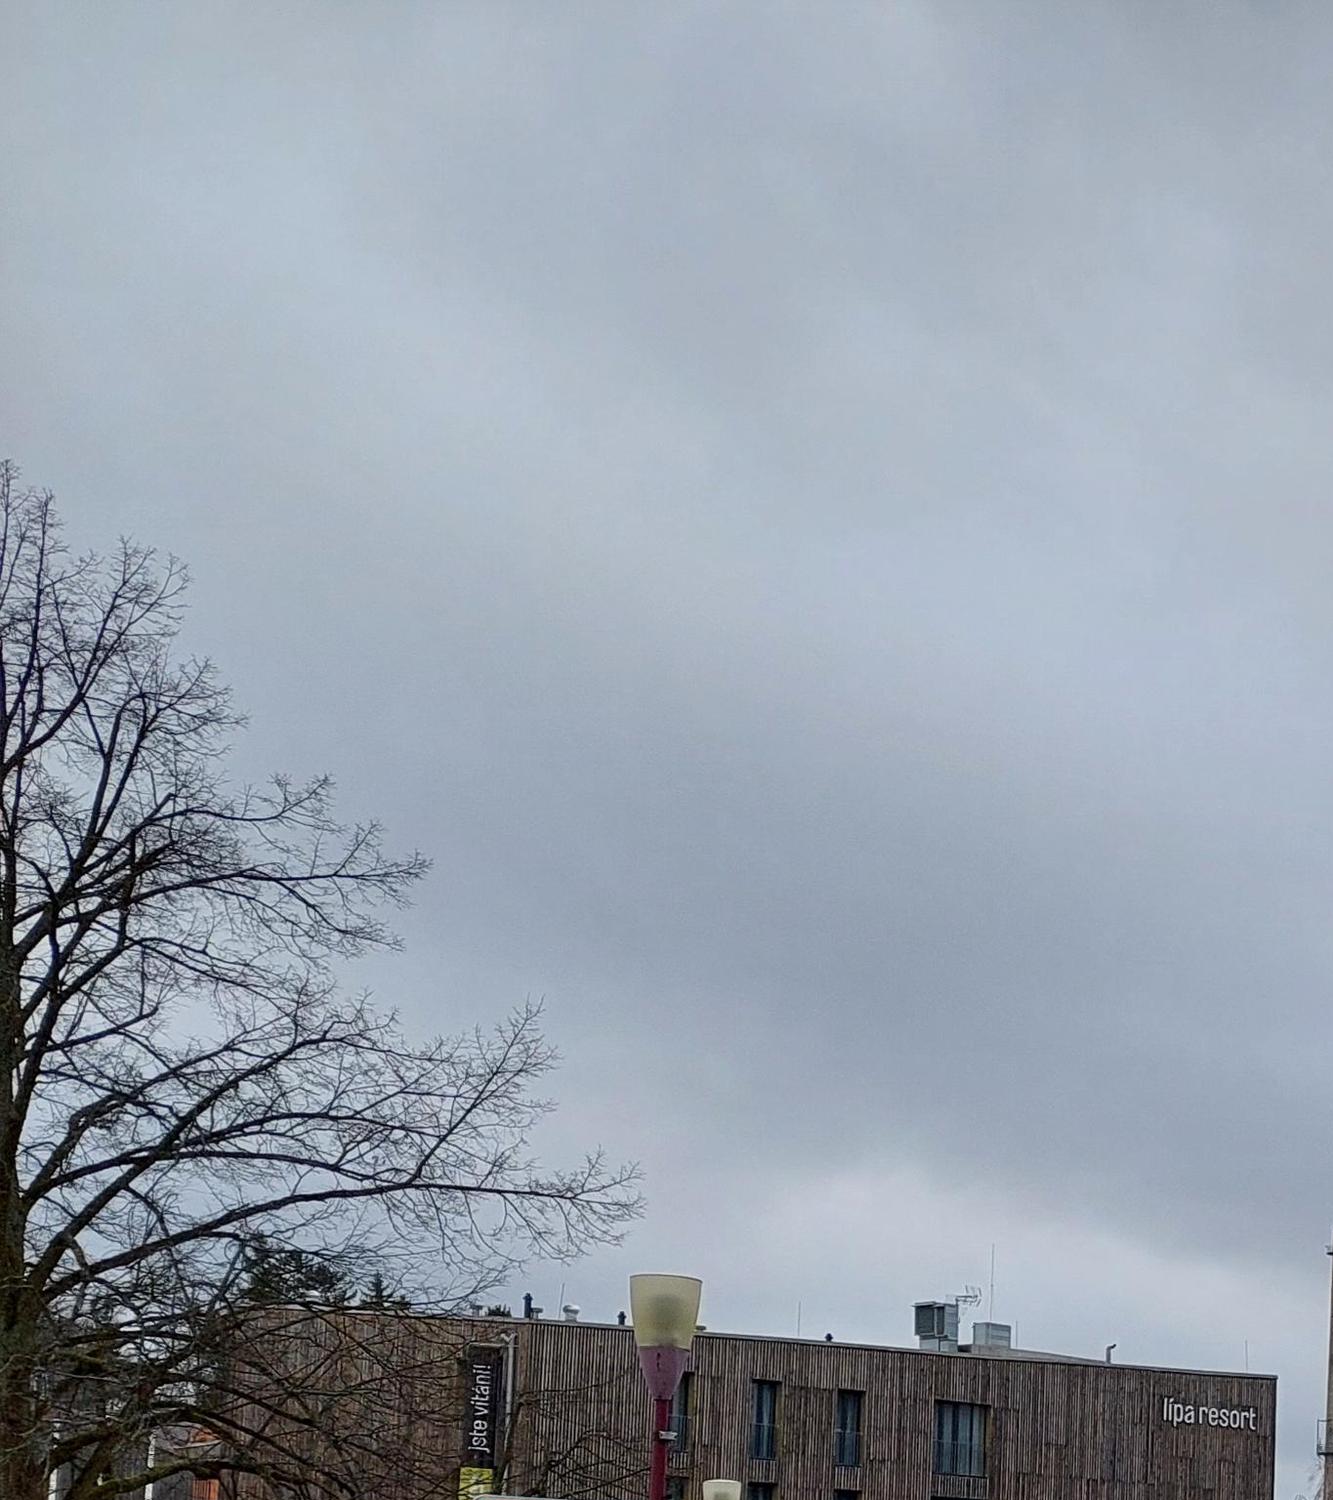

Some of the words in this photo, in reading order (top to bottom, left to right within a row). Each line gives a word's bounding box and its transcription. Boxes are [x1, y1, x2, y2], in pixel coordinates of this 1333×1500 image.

[1163, 1396, 1195, 1427] lípa
[1198, 1406, 1256, 1430] resort
[467, 1419, 491, 1454] jste
